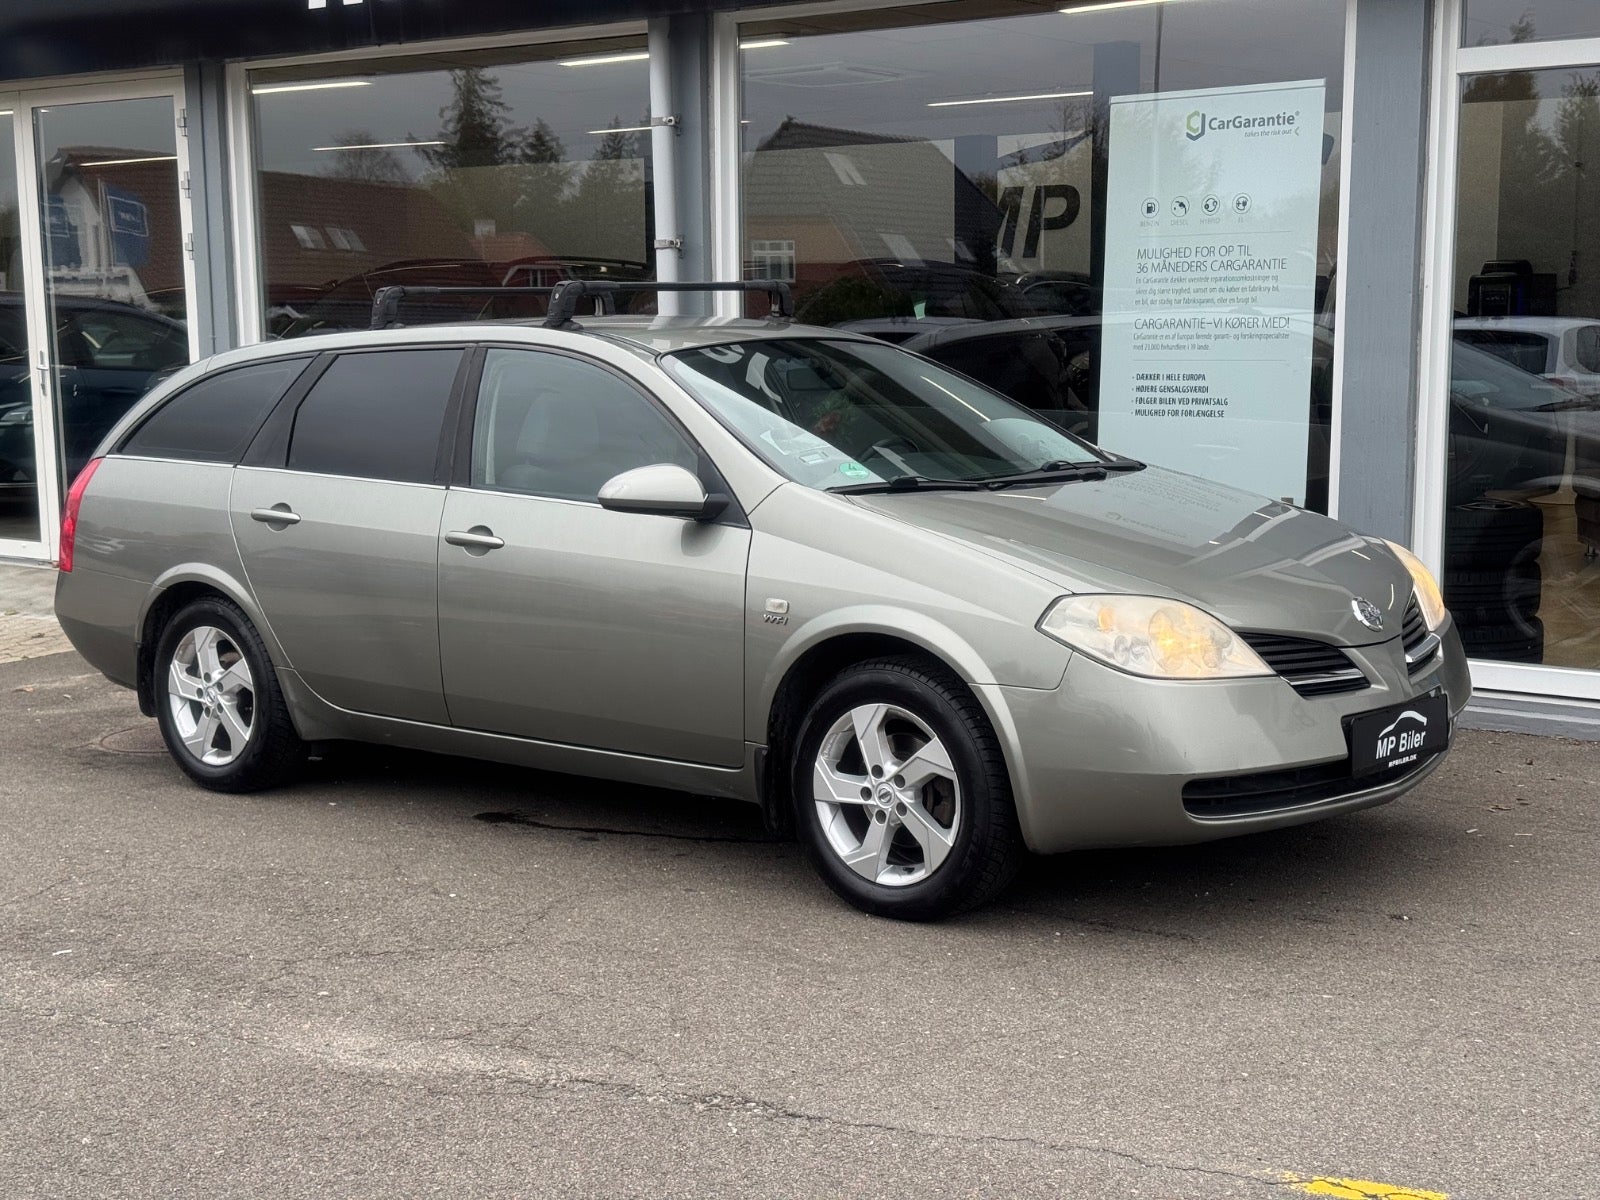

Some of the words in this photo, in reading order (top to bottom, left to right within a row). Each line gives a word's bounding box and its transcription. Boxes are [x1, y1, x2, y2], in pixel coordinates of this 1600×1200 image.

[1208, 112, 1295, 130] CarGarantie
[1136, 246, 1192, 260] MULIGHED
[1195, 246, 1216, 258] FOR
[1218, 245, 1234, 257] OP
[1238, 244, 1252, 256] TIL
[1136, 262, 1149, 274] 36
[1151, 258, 1208, 273] MÅNEDERS
[1210, 258, 1287, 272] CARGARANTIE
[1225, 317, 1260, 329] KØRER
[1262, 316, 1290, 329] MED!
[1136, 373, 1161, 381] DÆKKER
[1136, 385, 1158, 393] HØJERE
[1135, 398, 1158, 406] FØLGER
[1191, 398, 1229, 406] PRIVATSALG
[1134, 409, 1166, 418] MULIGHED
[1181, 410, 1225, 418] FORLÆNGELSE
[1376, 736, 1396, 760] MP
[1398, 730, 1426, 753] Biler
[1388, 754, 1417, 768] MPBILER.DK
